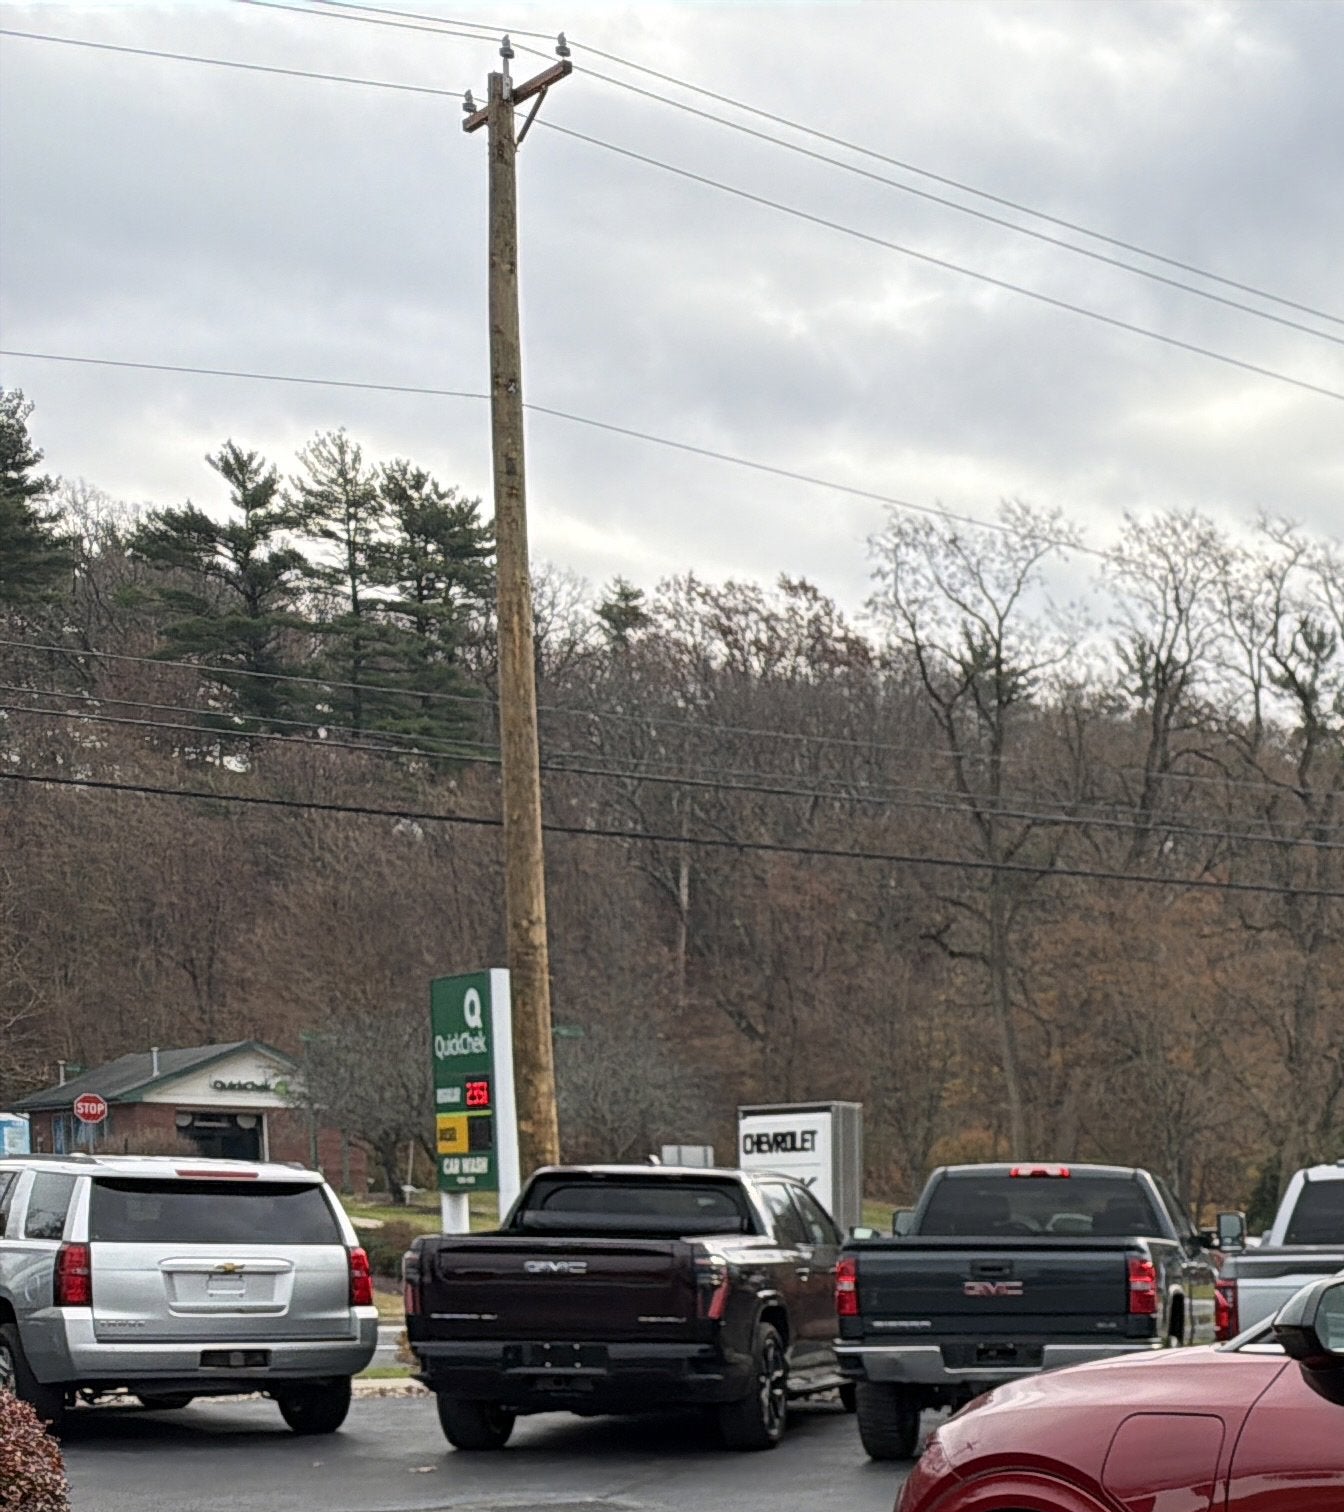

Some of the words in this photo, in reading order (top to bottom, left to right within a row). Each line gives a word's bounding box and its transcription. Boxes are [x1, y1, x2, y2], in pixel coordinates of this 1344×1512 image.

[464, 987, 483, 1029] Q
[435, 1030, 488, 1060] QuickChek
[76, 1102, 105, 1115] STOP
[742, 1130, 818, 1155] CHEVROLET
[523, 1260, 588, 1274] GMC
[963, 1281, 1024, 1295] GMC
